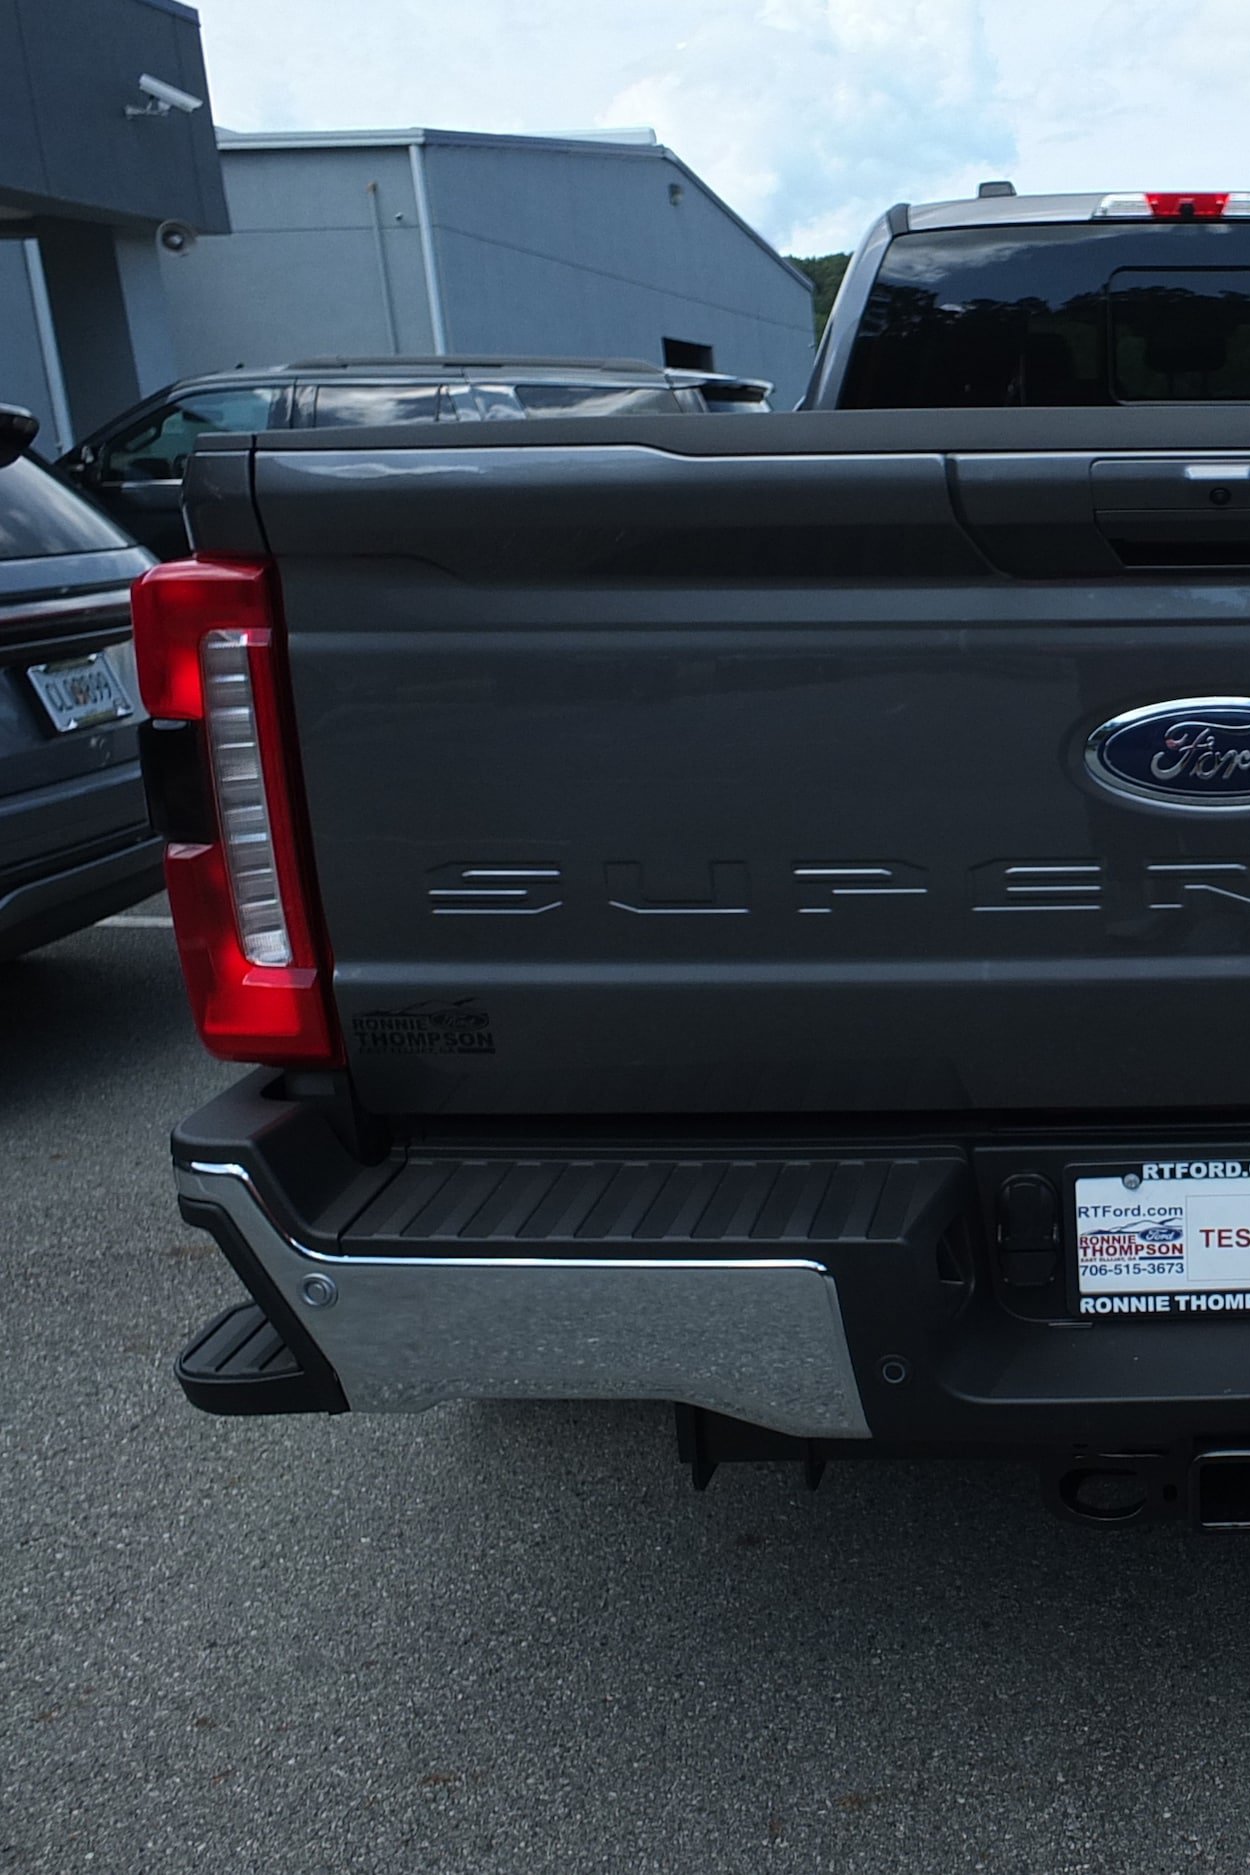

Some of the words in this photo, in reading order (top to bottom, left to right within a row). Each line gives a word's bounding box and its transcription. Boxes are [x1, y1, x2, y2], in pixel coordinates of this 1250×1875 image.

[352, 1018, 428, 1031] RONNIE
[354, 1031, 495, 1047] THOMPSON
[1078, 1205, 1183, 1218] RTFord.com
[1080, 1234, 1137, 1246] RONNIE
[1080, 1243, 1184, 1257] THOMPSON
[1080, 1262, 1184, 1277] 706-515-3673
[1079, 1294, 1171, 1314] RONNIE
